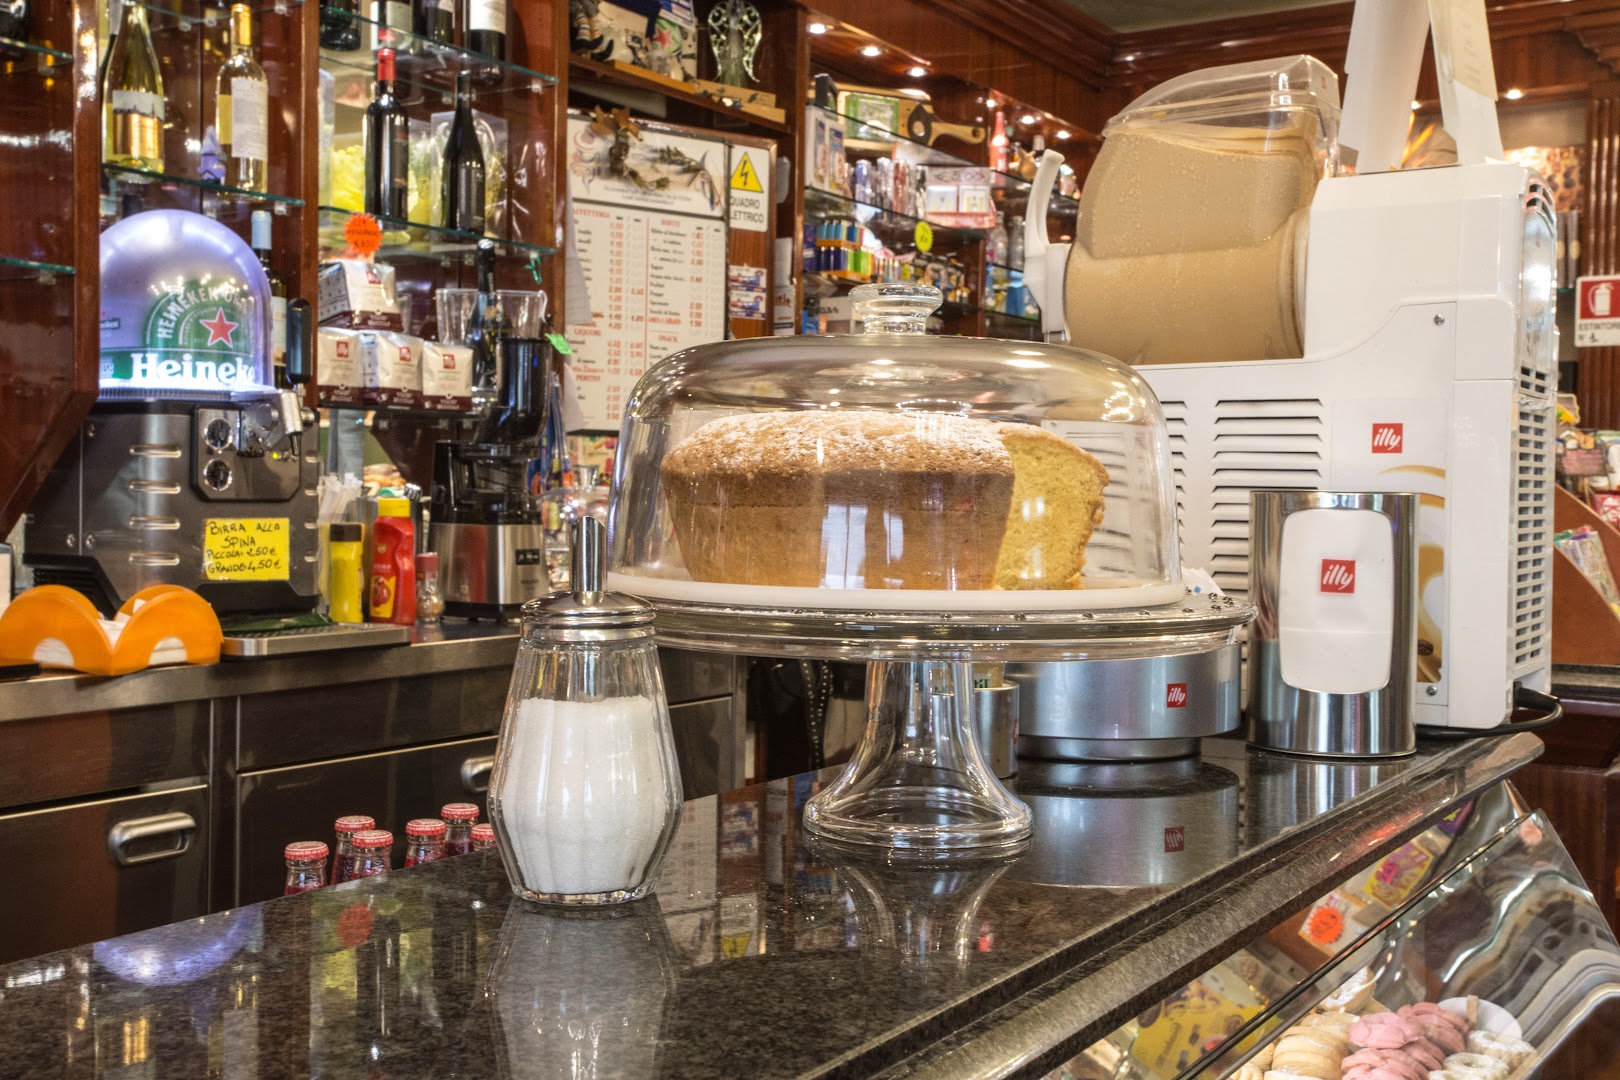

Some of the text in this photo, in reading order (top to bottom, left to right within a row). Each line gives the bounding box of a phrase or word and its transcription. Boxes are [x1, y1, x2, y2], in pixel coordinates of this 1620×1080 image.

[730, 210, 764, 223] LETTRICO
[131, 352, 256, 384] Heineke
[1373, 428, 1401, 451] illy
[206, 521, 280, 535] BIRRA ALLA
[221, 535, 256, 549] SPINA
[1323, 564, 1354, 589] illy
[1168, 686, 1186, 704] illy
